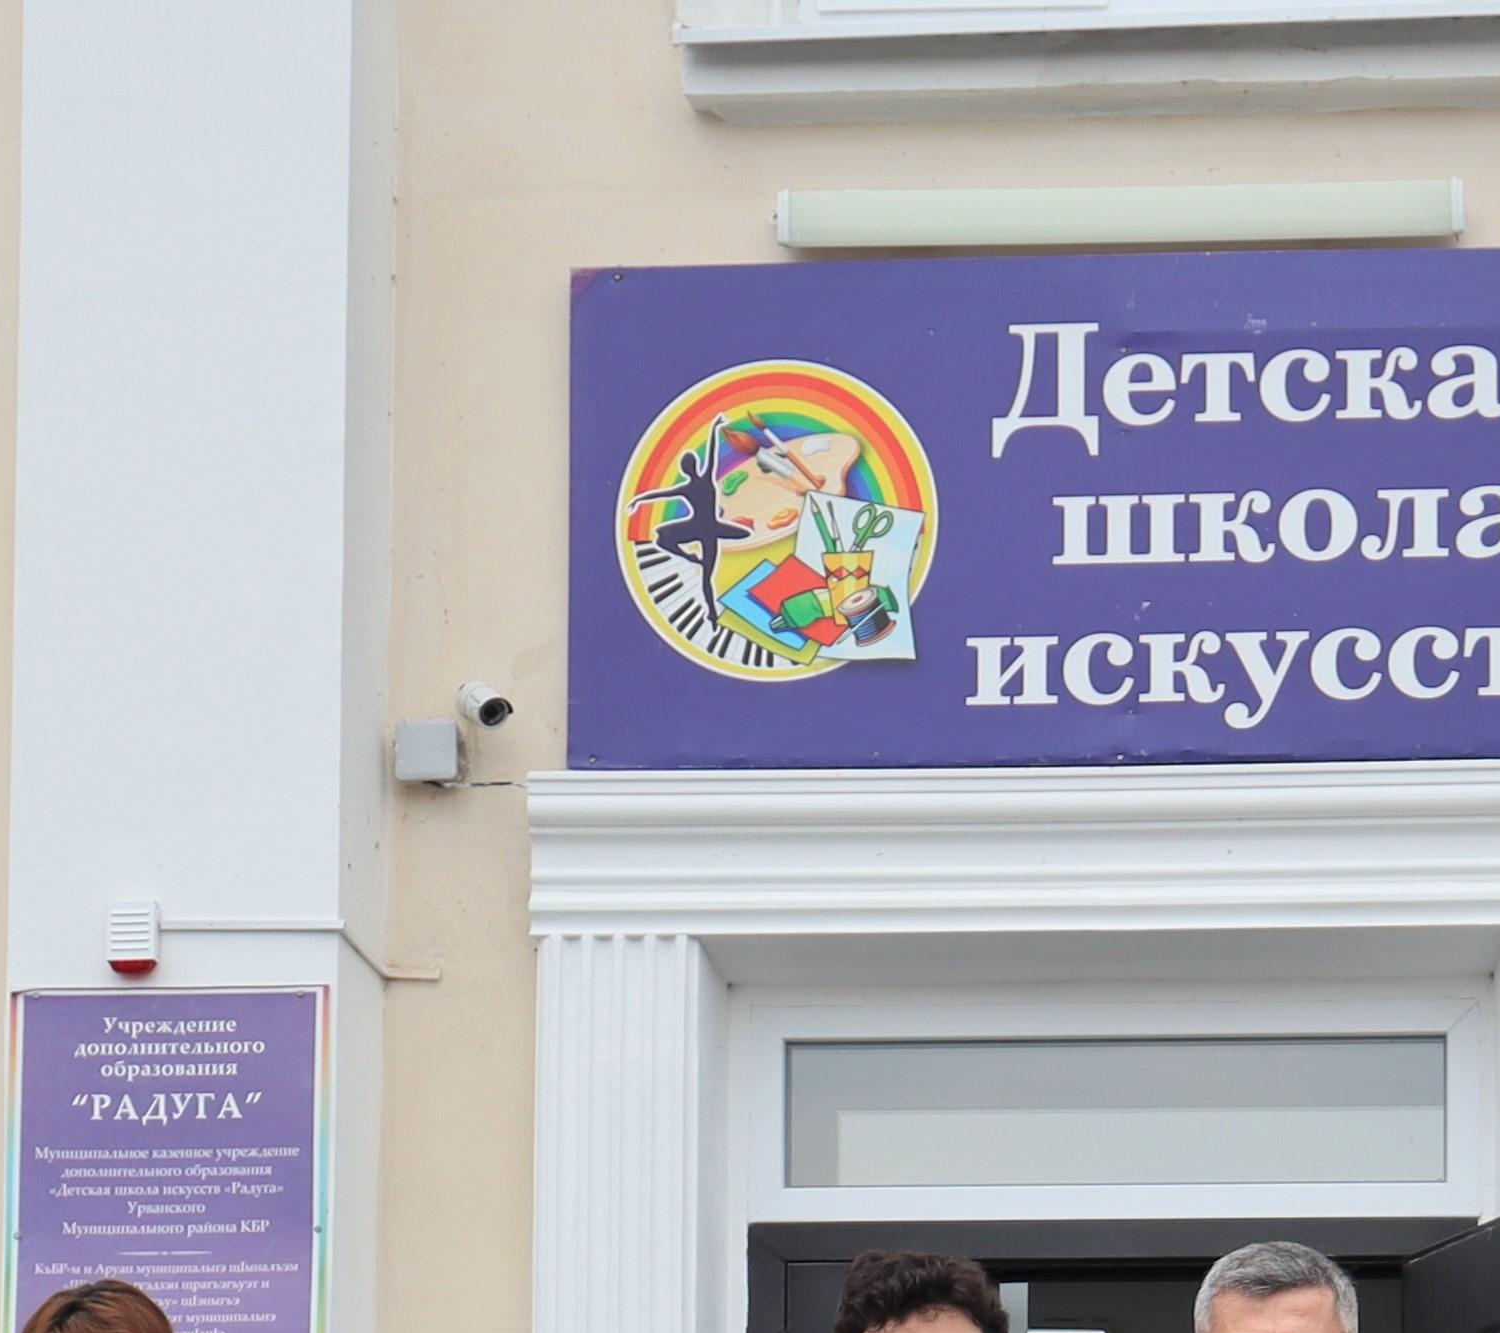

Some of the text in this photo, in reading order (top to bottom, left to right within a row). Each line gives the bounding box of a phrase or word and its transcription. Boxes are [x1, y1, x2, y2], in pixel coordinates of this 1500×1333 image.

[103, 1016, 237, 1039] Учреждение
[73, 1040, 265, 1058] дополнительного
[100, 1060, 238, 1082] образования
[34, 1147, 300, 1164] Муниципальное казенное учреждение
[60, 1164, 272, 1180] дополнительного образования
[49, 1181, 284, 1199] «Детская школа искусств «Радуга»
[127, 1201, 206, 1218] Урванского
[62, 1219, 270, 1239] Муниципального района КБР
[83, 1265, 93, 1275] и
